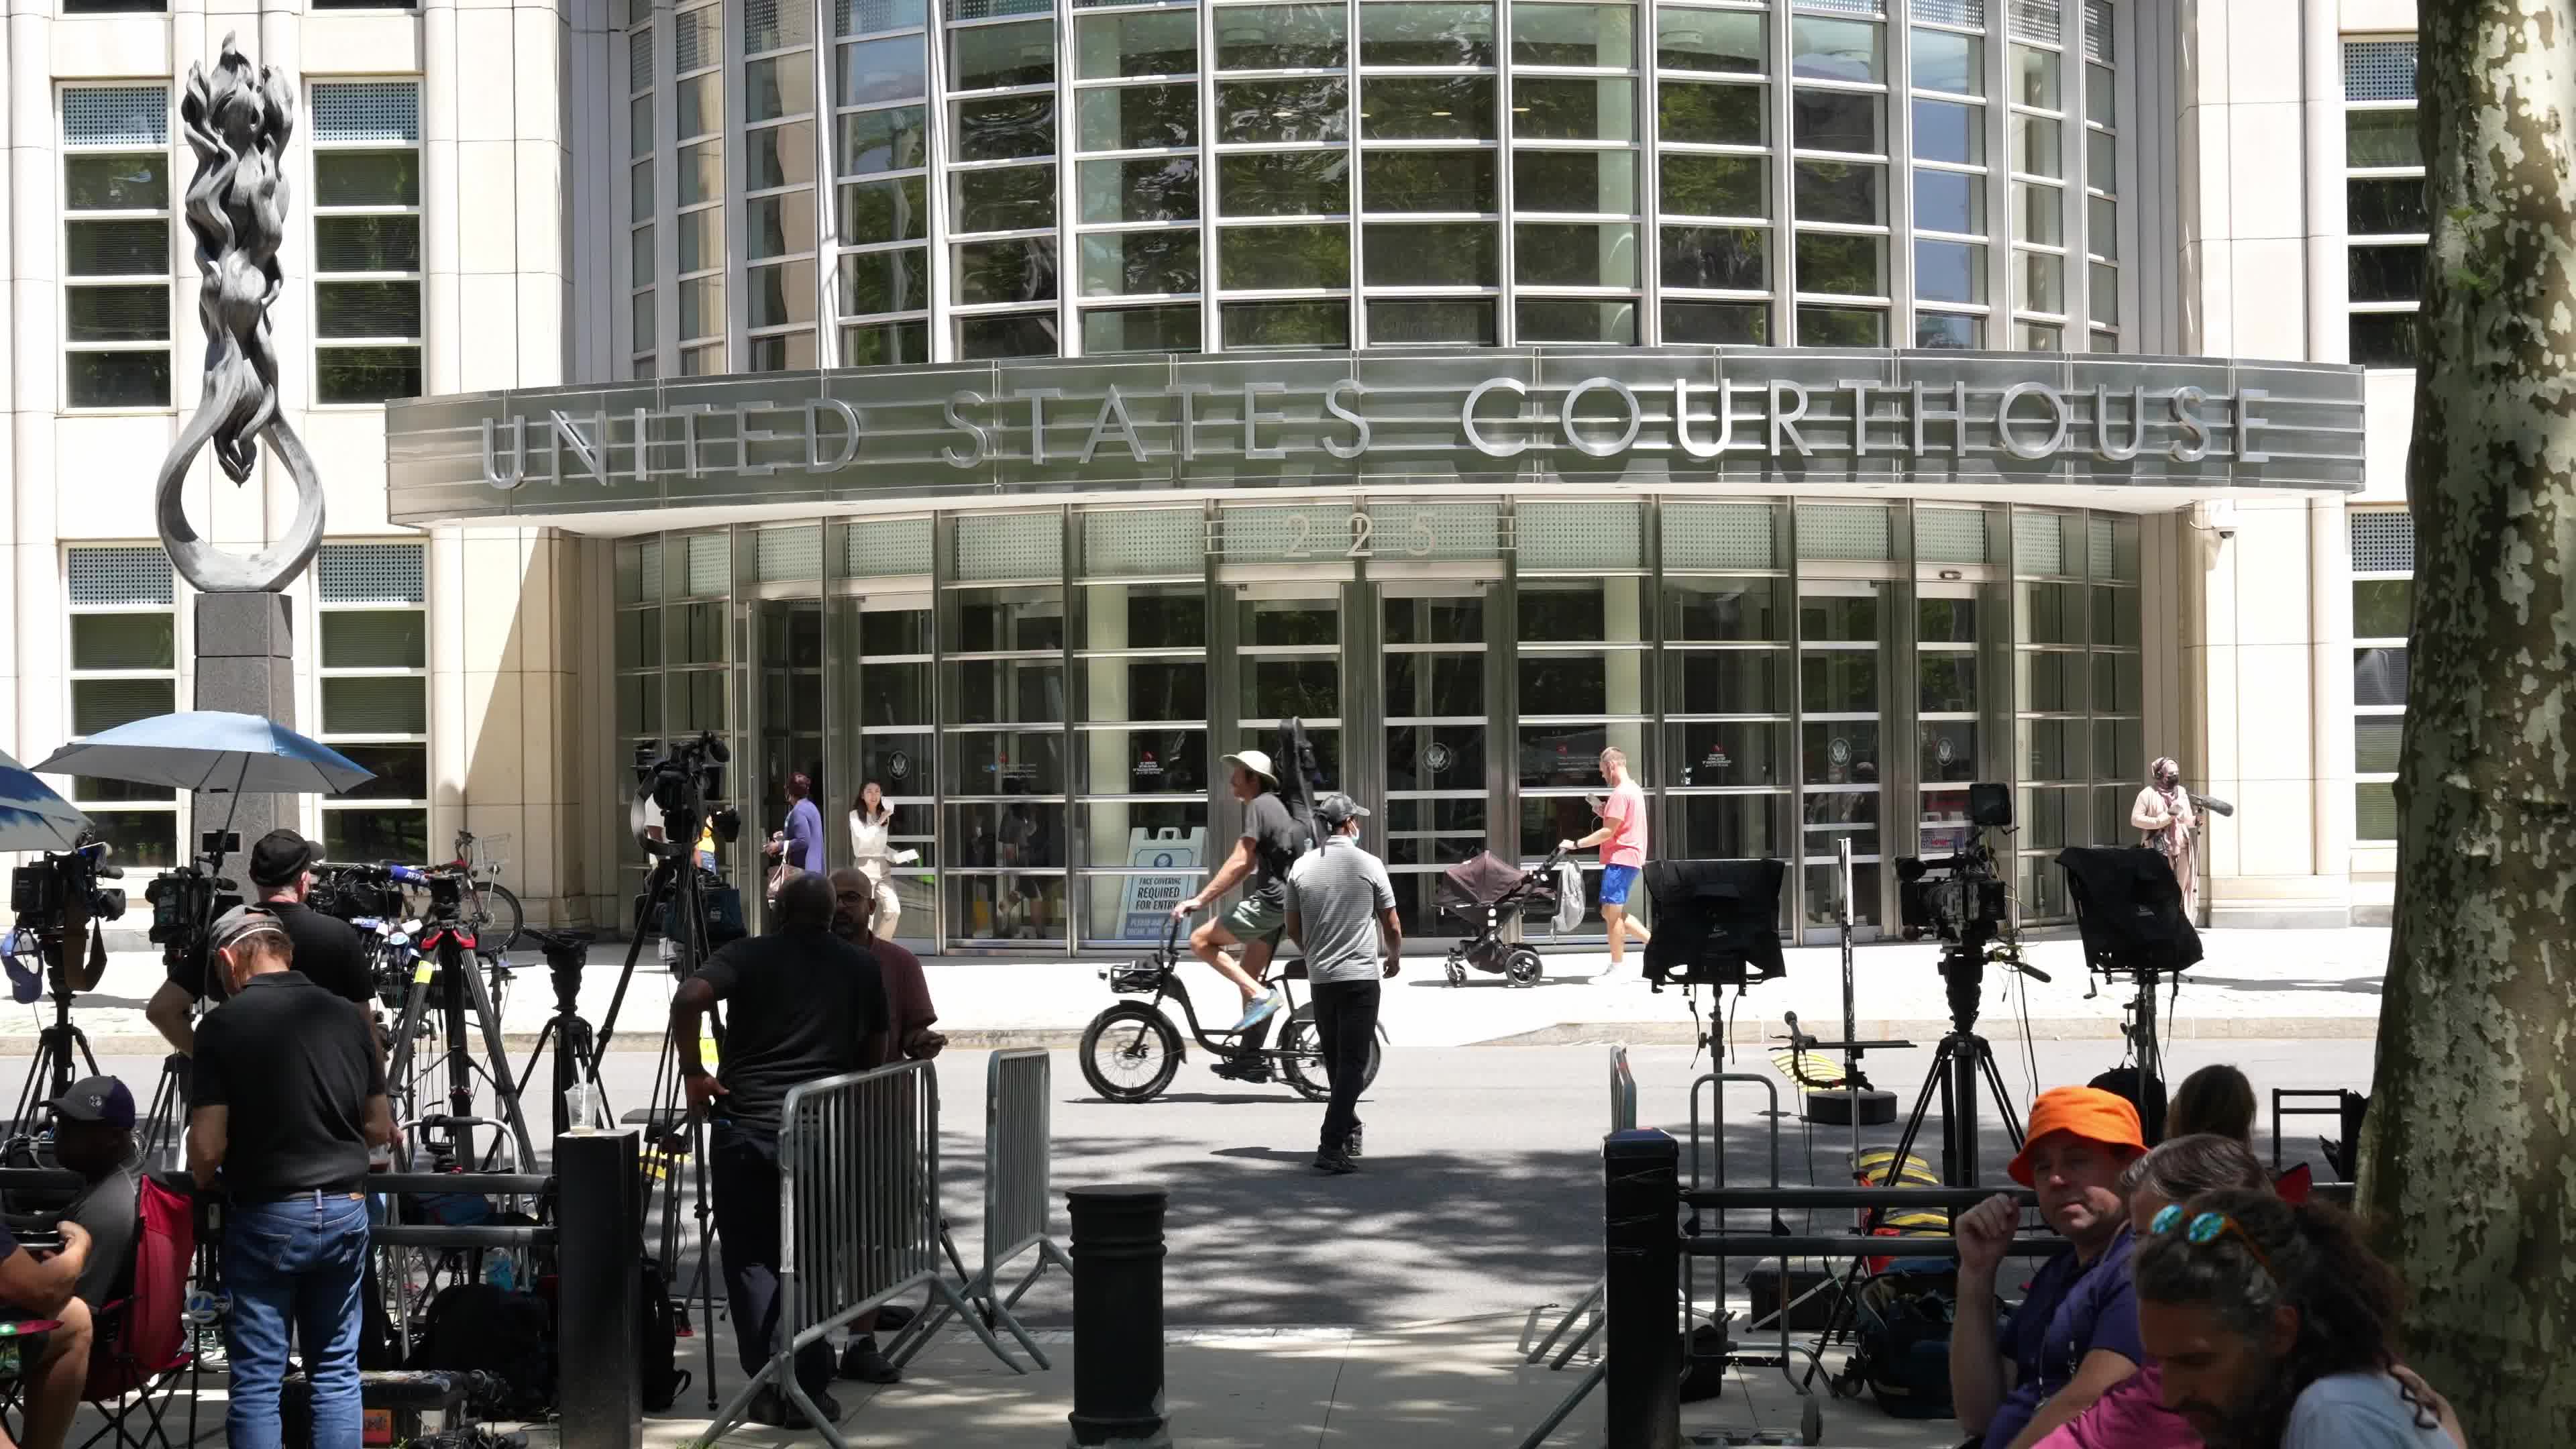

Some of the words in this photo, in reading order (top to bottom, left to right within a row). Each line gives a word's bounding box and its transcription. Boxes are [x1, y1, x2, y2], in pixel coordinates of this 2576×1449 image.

[482, 398, 860, 490] UNITED
[942, 379, 1371, 468] STATES
[1463, 376, 2269, 463] COURTHOUSE
[1284, 512, 1436, 557] 225
[1136, 900, 1152, 910] FOR
[1137, 886, 1180, 900] REQUIRED
